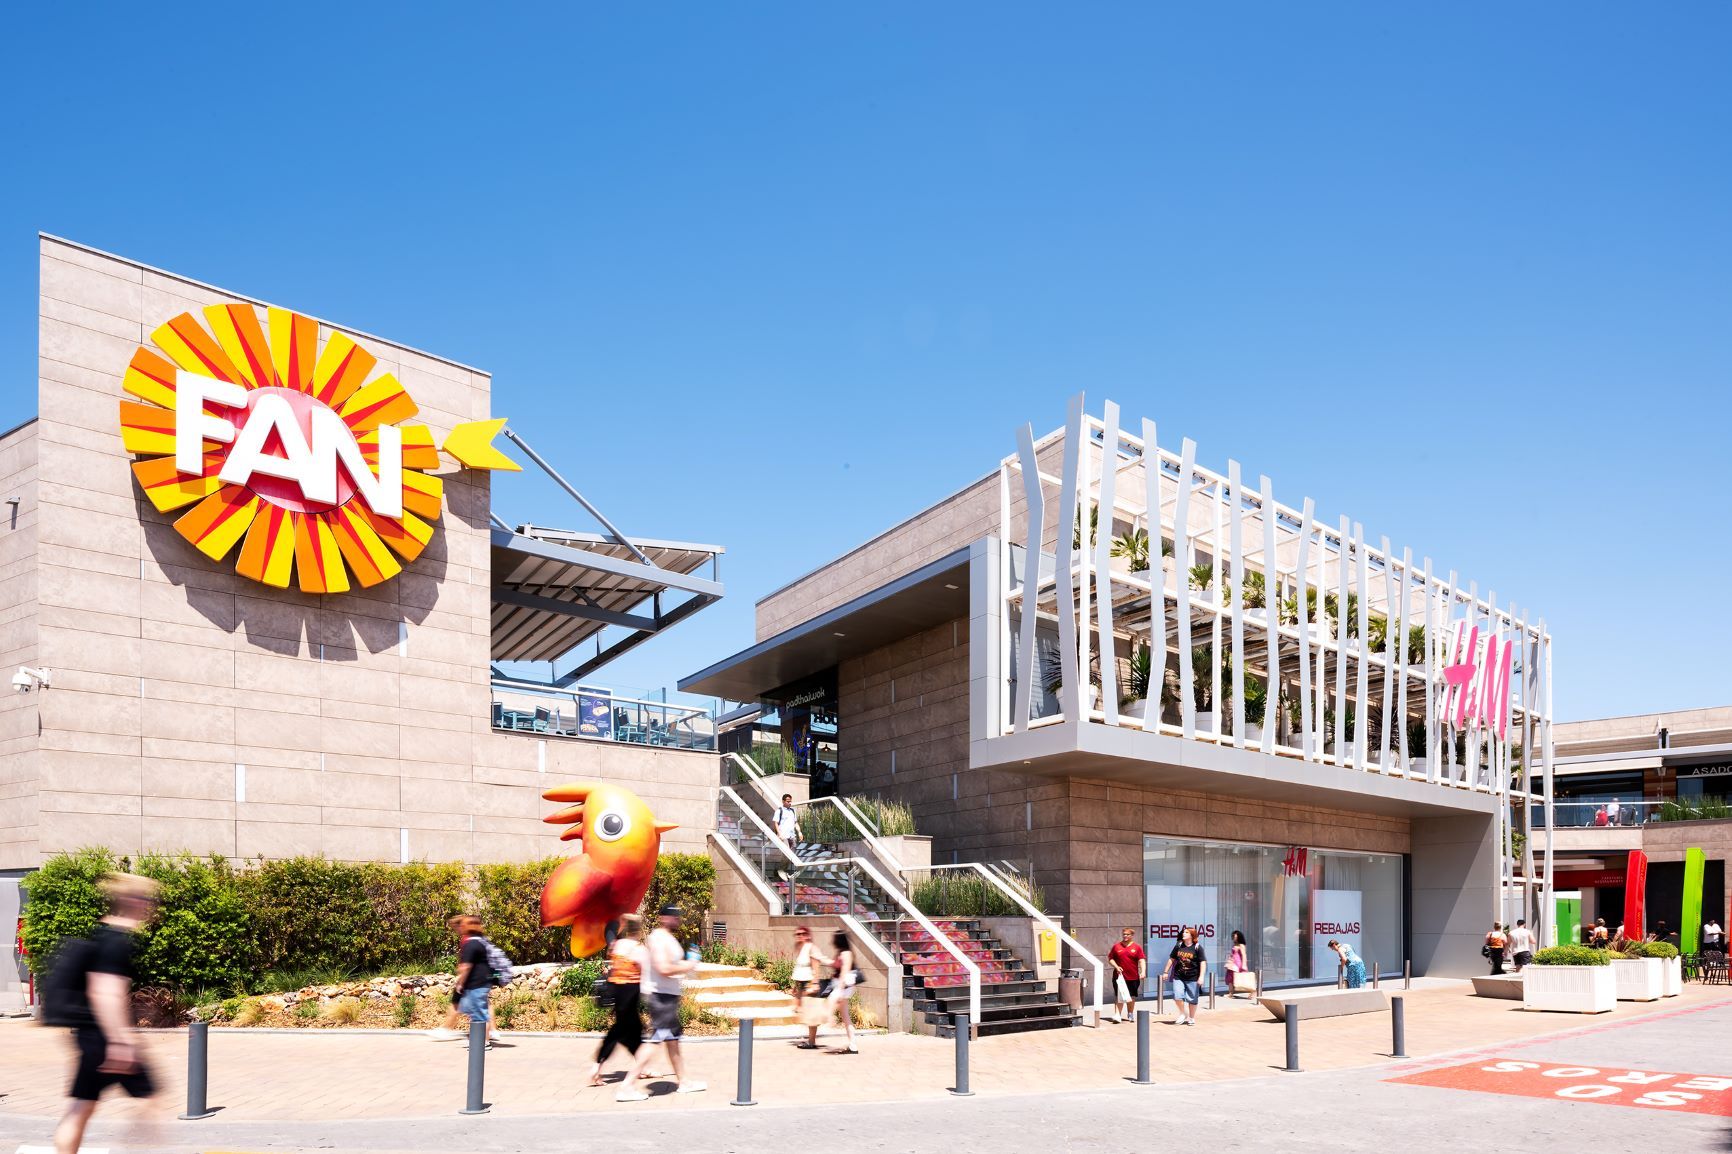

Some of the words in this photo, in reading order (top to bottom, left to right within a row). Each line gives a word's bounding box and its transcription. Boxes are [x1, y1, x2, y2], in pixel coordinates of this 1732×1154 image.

[175, 369, 403, 519] FAN
[1443, 621, 1512, 741] H&M
[1282, 848, 1307, 877] H&M
[1150, 924, 1215, 939] REBAS
[1314, 922, 1360, 935] REBAJAS
